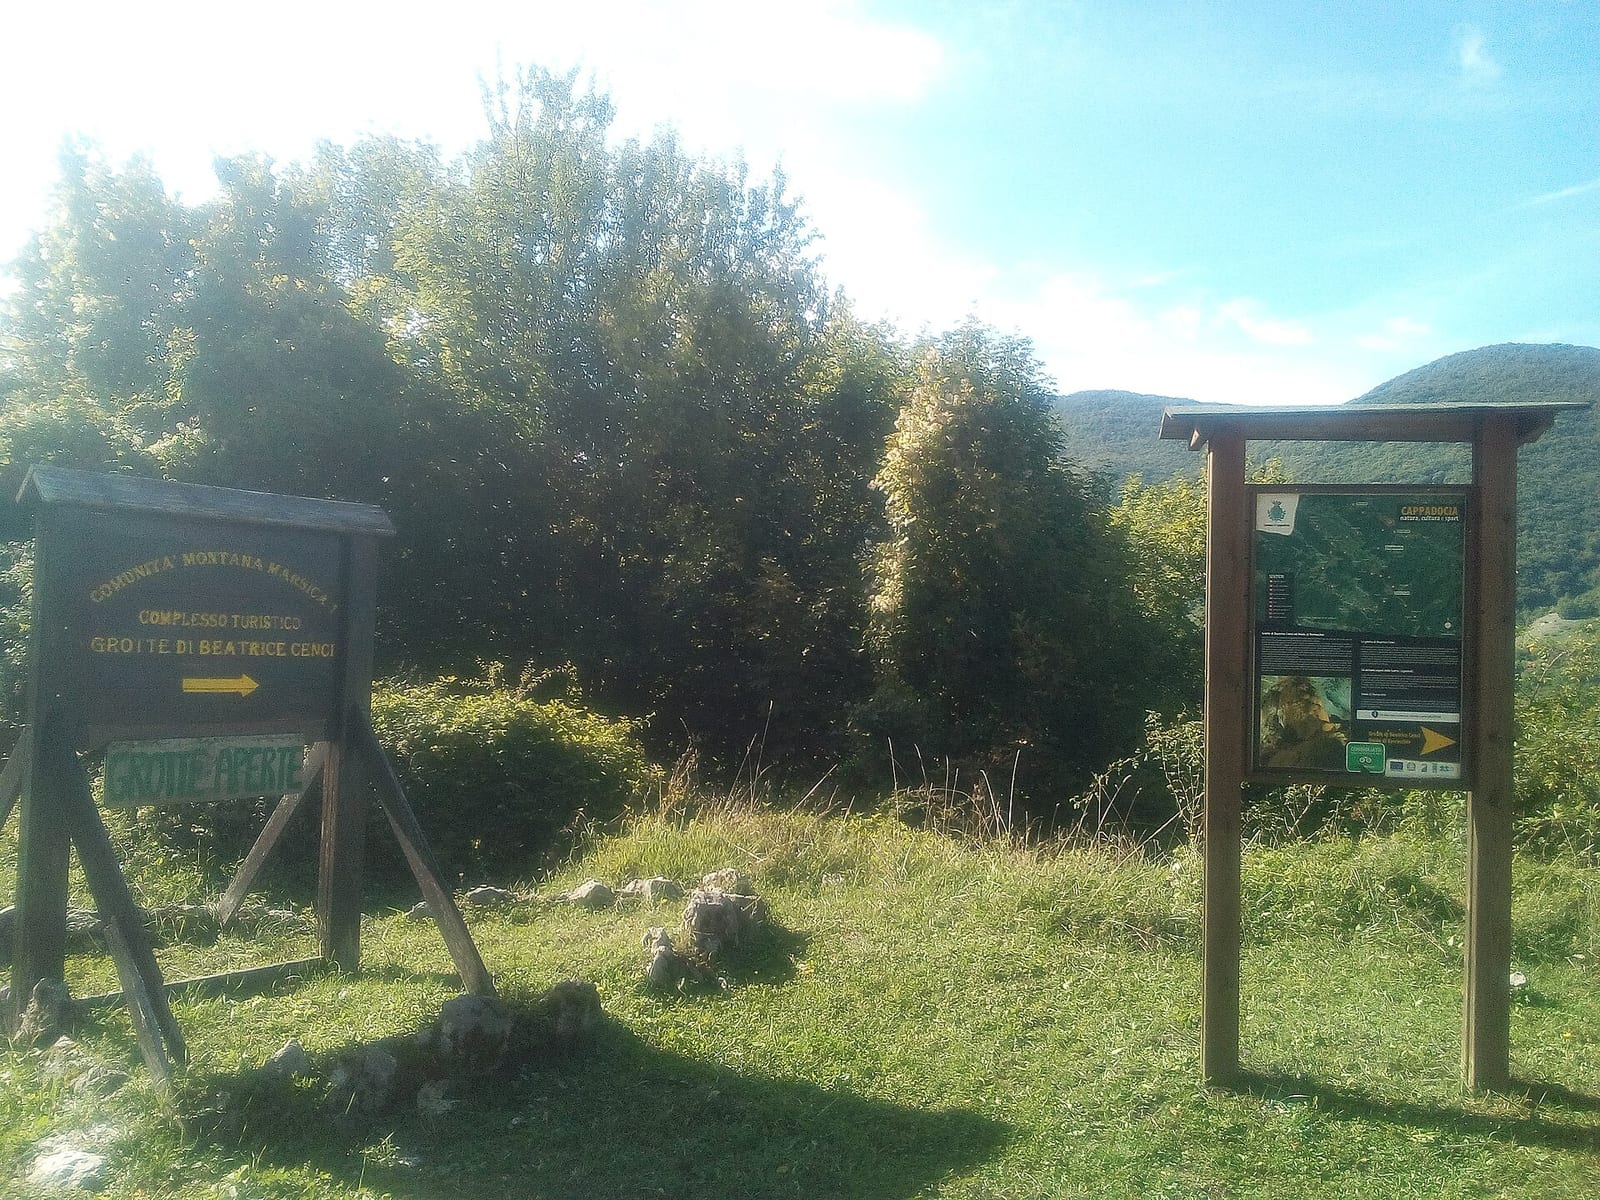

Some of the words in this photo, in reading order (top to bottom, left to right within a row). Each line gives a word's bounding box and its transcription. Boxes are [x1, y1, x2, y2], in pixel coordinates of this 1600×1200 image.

[1401, 506, 1458, 516] CAPPADOCIA
[182, 551, 263, 570] MONTANA
[267, 562, 328, 605] MARSICA
[139, 610, 228, 628] COMPLESSO
[232, 614, 302, 630] TURISTICO
[176, 639, 194, 655] DI
[200, 640, 287, 657] BEATRICE
[291, 643, 336, 658] CENCI
[106, 749, 208, 803] GROTTE
[213, 746, 303, 795] APERTE
